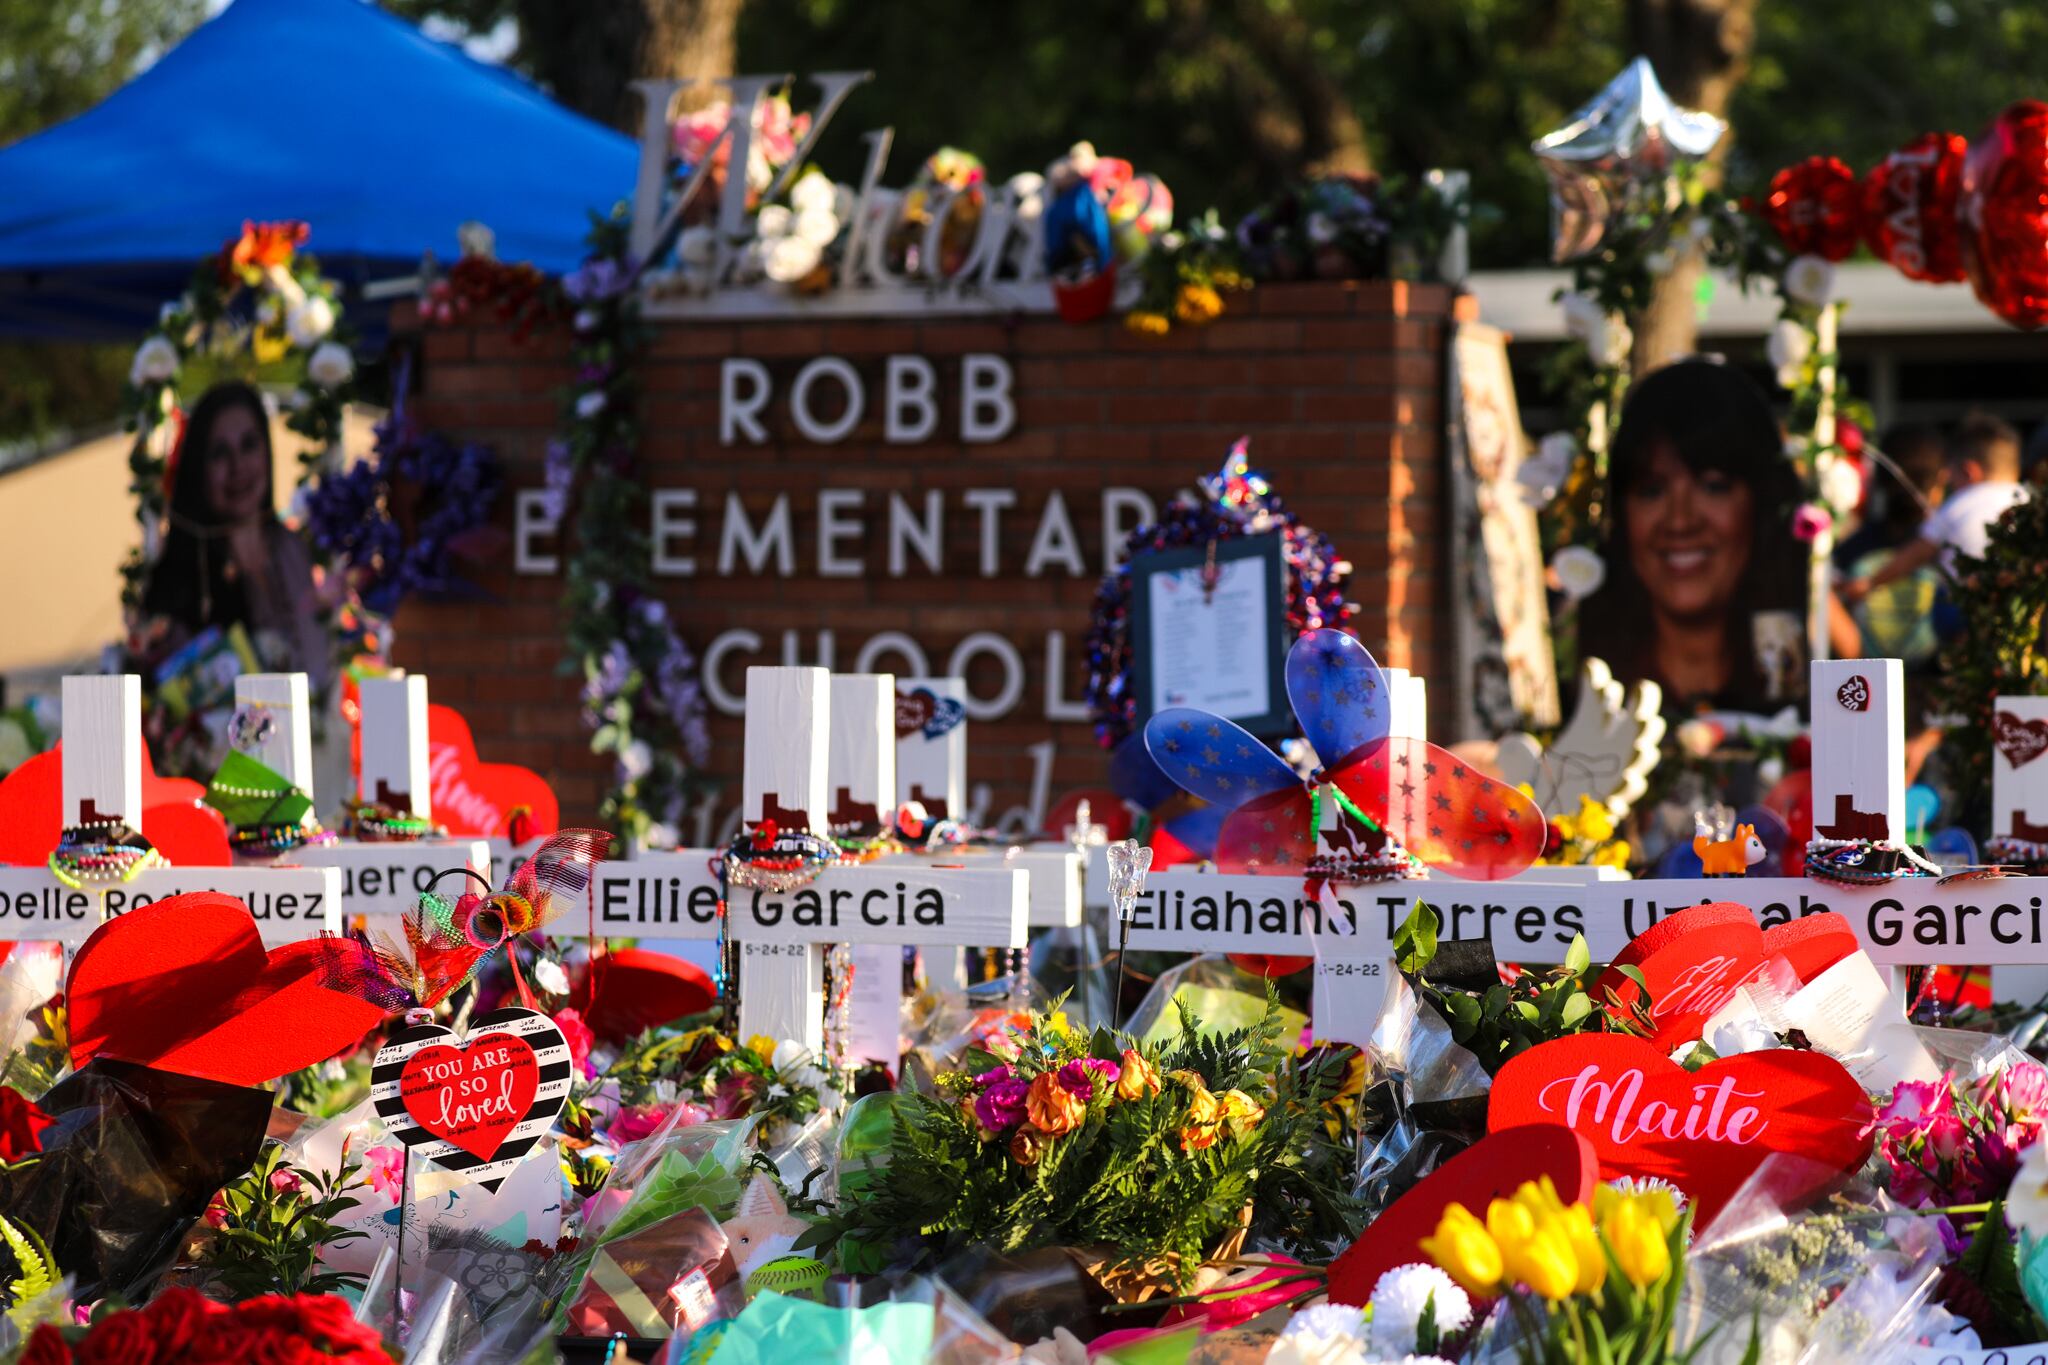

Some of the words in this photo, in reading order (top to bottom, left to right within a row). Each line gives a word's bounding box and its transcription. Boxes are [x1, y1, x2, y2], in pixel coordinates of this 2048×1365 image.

[720, 353, 1016, 443] ROBB
[602, 877, 718, 923] Ellie
[751, 881, 944, 927] Garcia
[1867, 897, 2043, 947] Garci
[745, 943, 804, 957] 5-24-22
[422, 1059, 462, 1083] YOU
[472, 1047, 511, 1072] ARE
[460, 1076, 488, 1097] SO
[430, 1069, 517, 1129] loved
[1539, 1064, 1770, 1145] Maite
